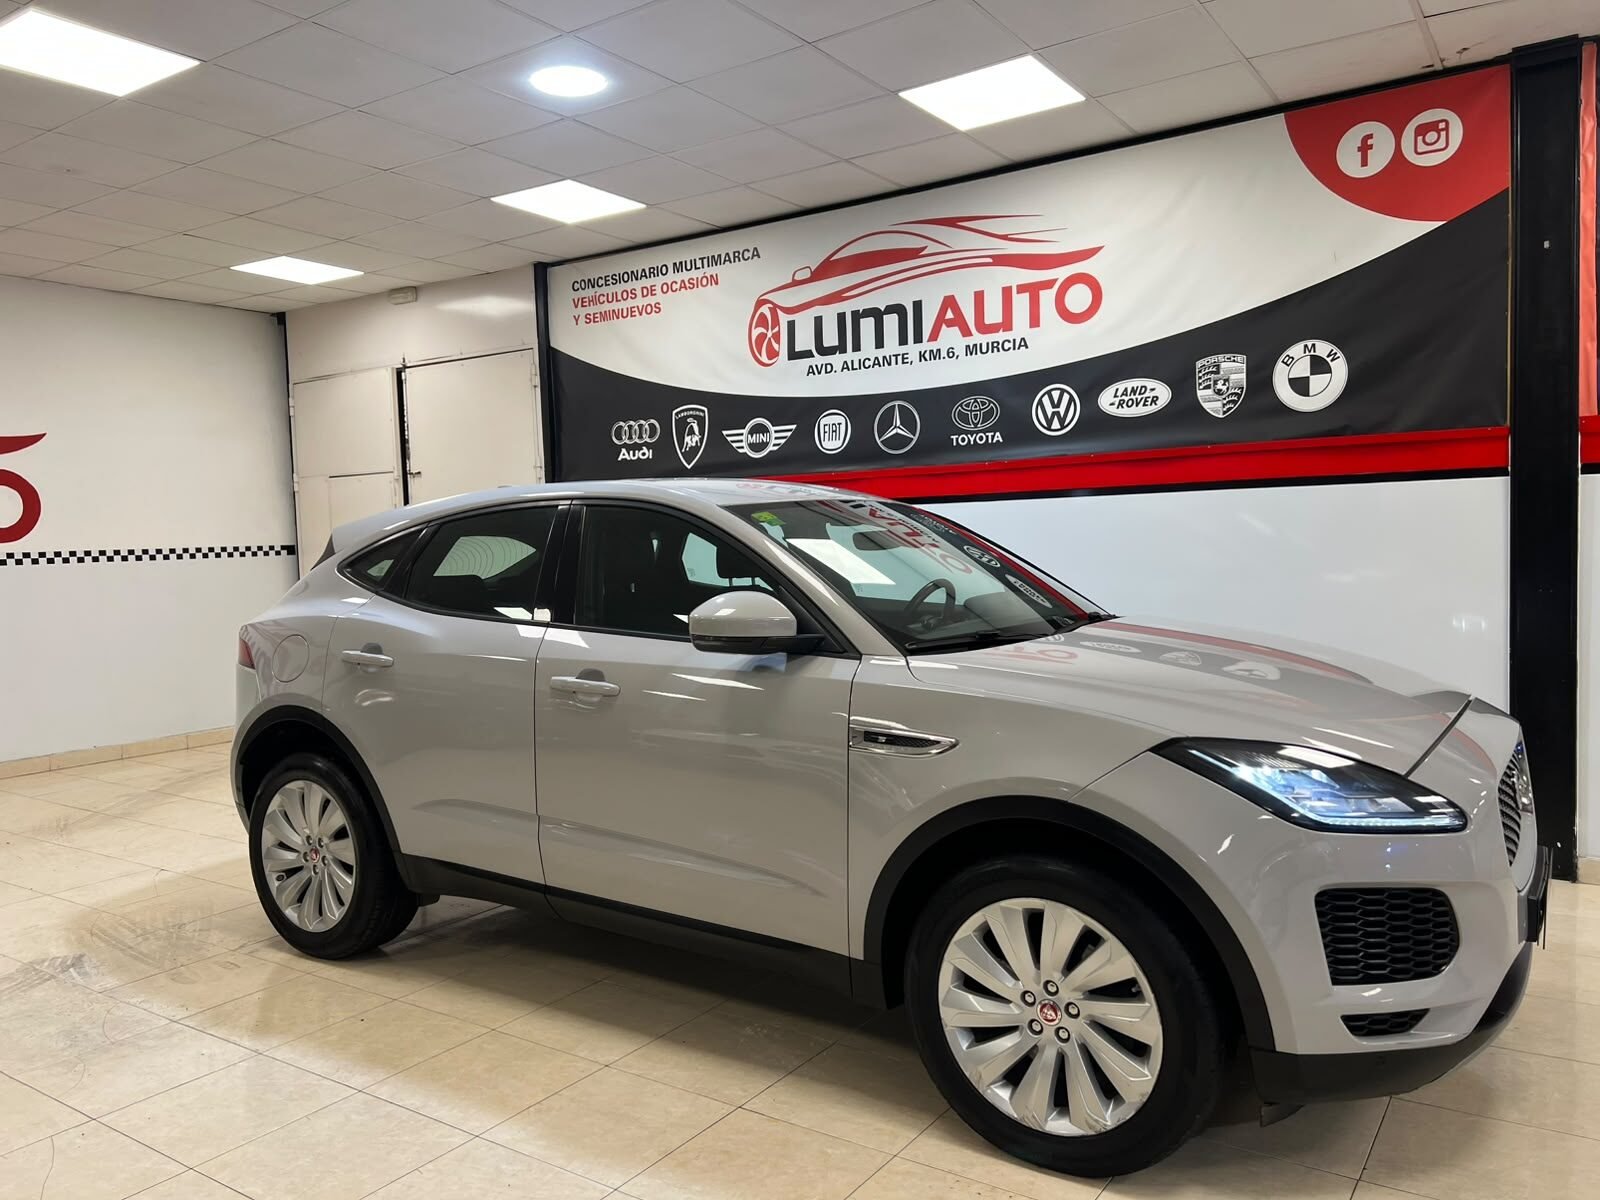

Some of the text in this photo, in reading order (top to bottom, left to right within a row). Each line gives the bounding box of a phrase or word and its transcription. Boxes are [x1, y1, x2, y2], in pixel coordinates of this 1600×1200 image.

[571, 246, 761, 291] CONCESIONARIO MULTIMARCA
[572, 272, 719, 309] VEHÍCULOS DE OCASIÓN
[573, 302, 662, 326] Y SEMINUEVOS
[806, 337, 1029, 377] AVD. ALICANTE, KM.6, MURCIA
[1198, 355, 1244, 367] PORSCHE
[747, 432, 770, 445] MINI
[823, 422, 843, 443] FIAT
[950, 432, 1003, 447] TOYOTA
[617, 448, 653, 461] Audi
